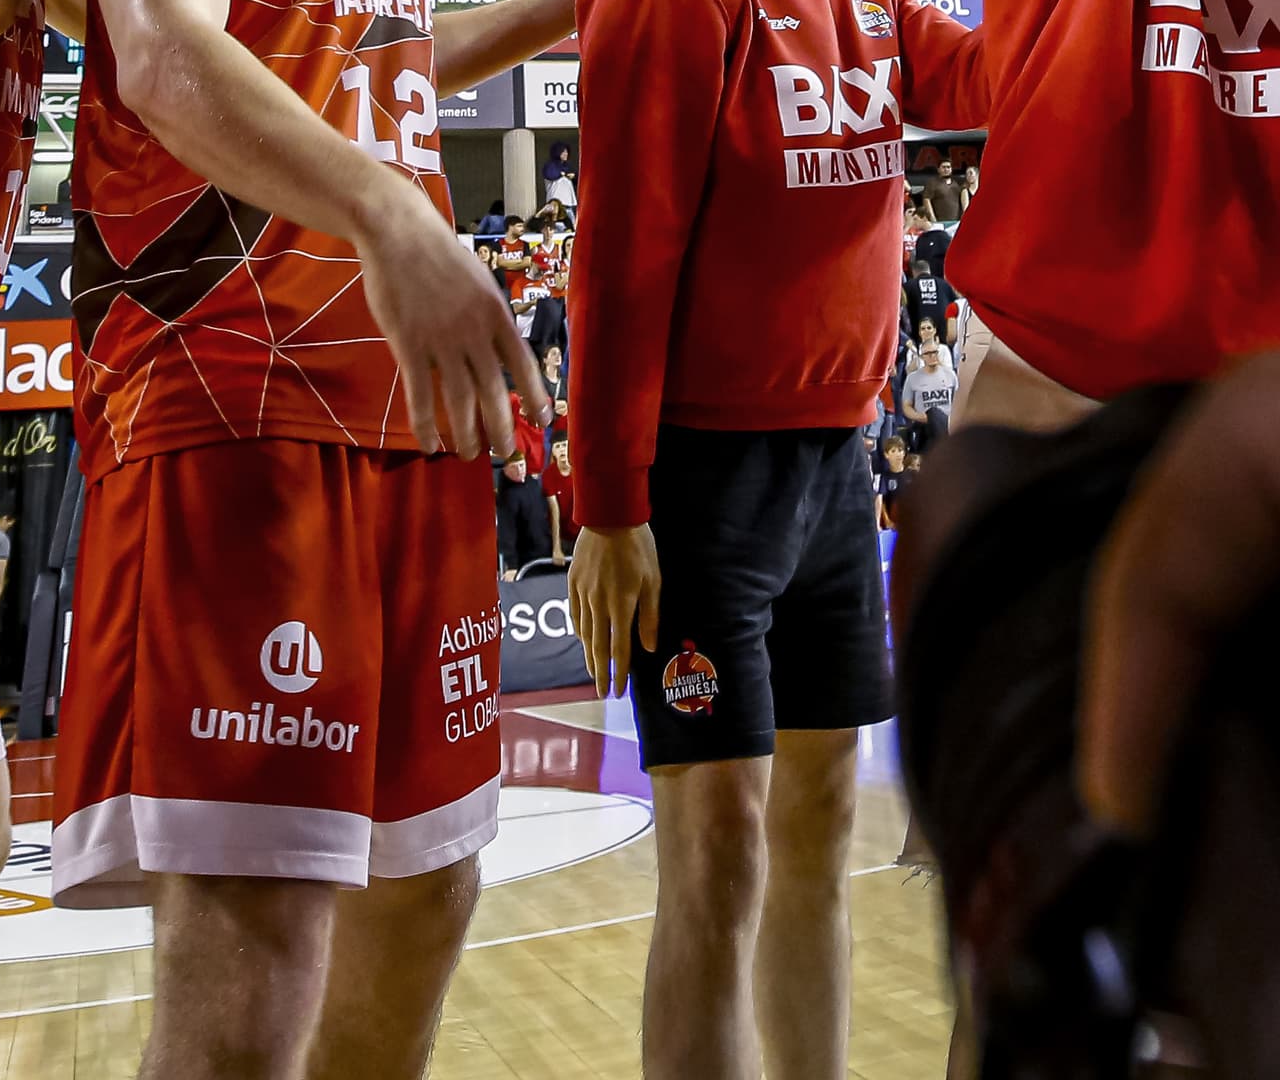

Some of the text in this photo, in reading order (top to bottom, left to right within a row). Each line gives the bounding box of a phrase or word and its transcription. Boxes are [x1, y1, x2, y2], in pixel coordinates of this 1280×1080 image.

[341, 64, 441, 173] 12
[768, 56, 902, 137] BAX
[500, 598, 575, 642] sa
[440, 653, 488, 704] ETL
[665, 679, 719, 704] MANRESA
[190, 701, 360, 753] unilabor
